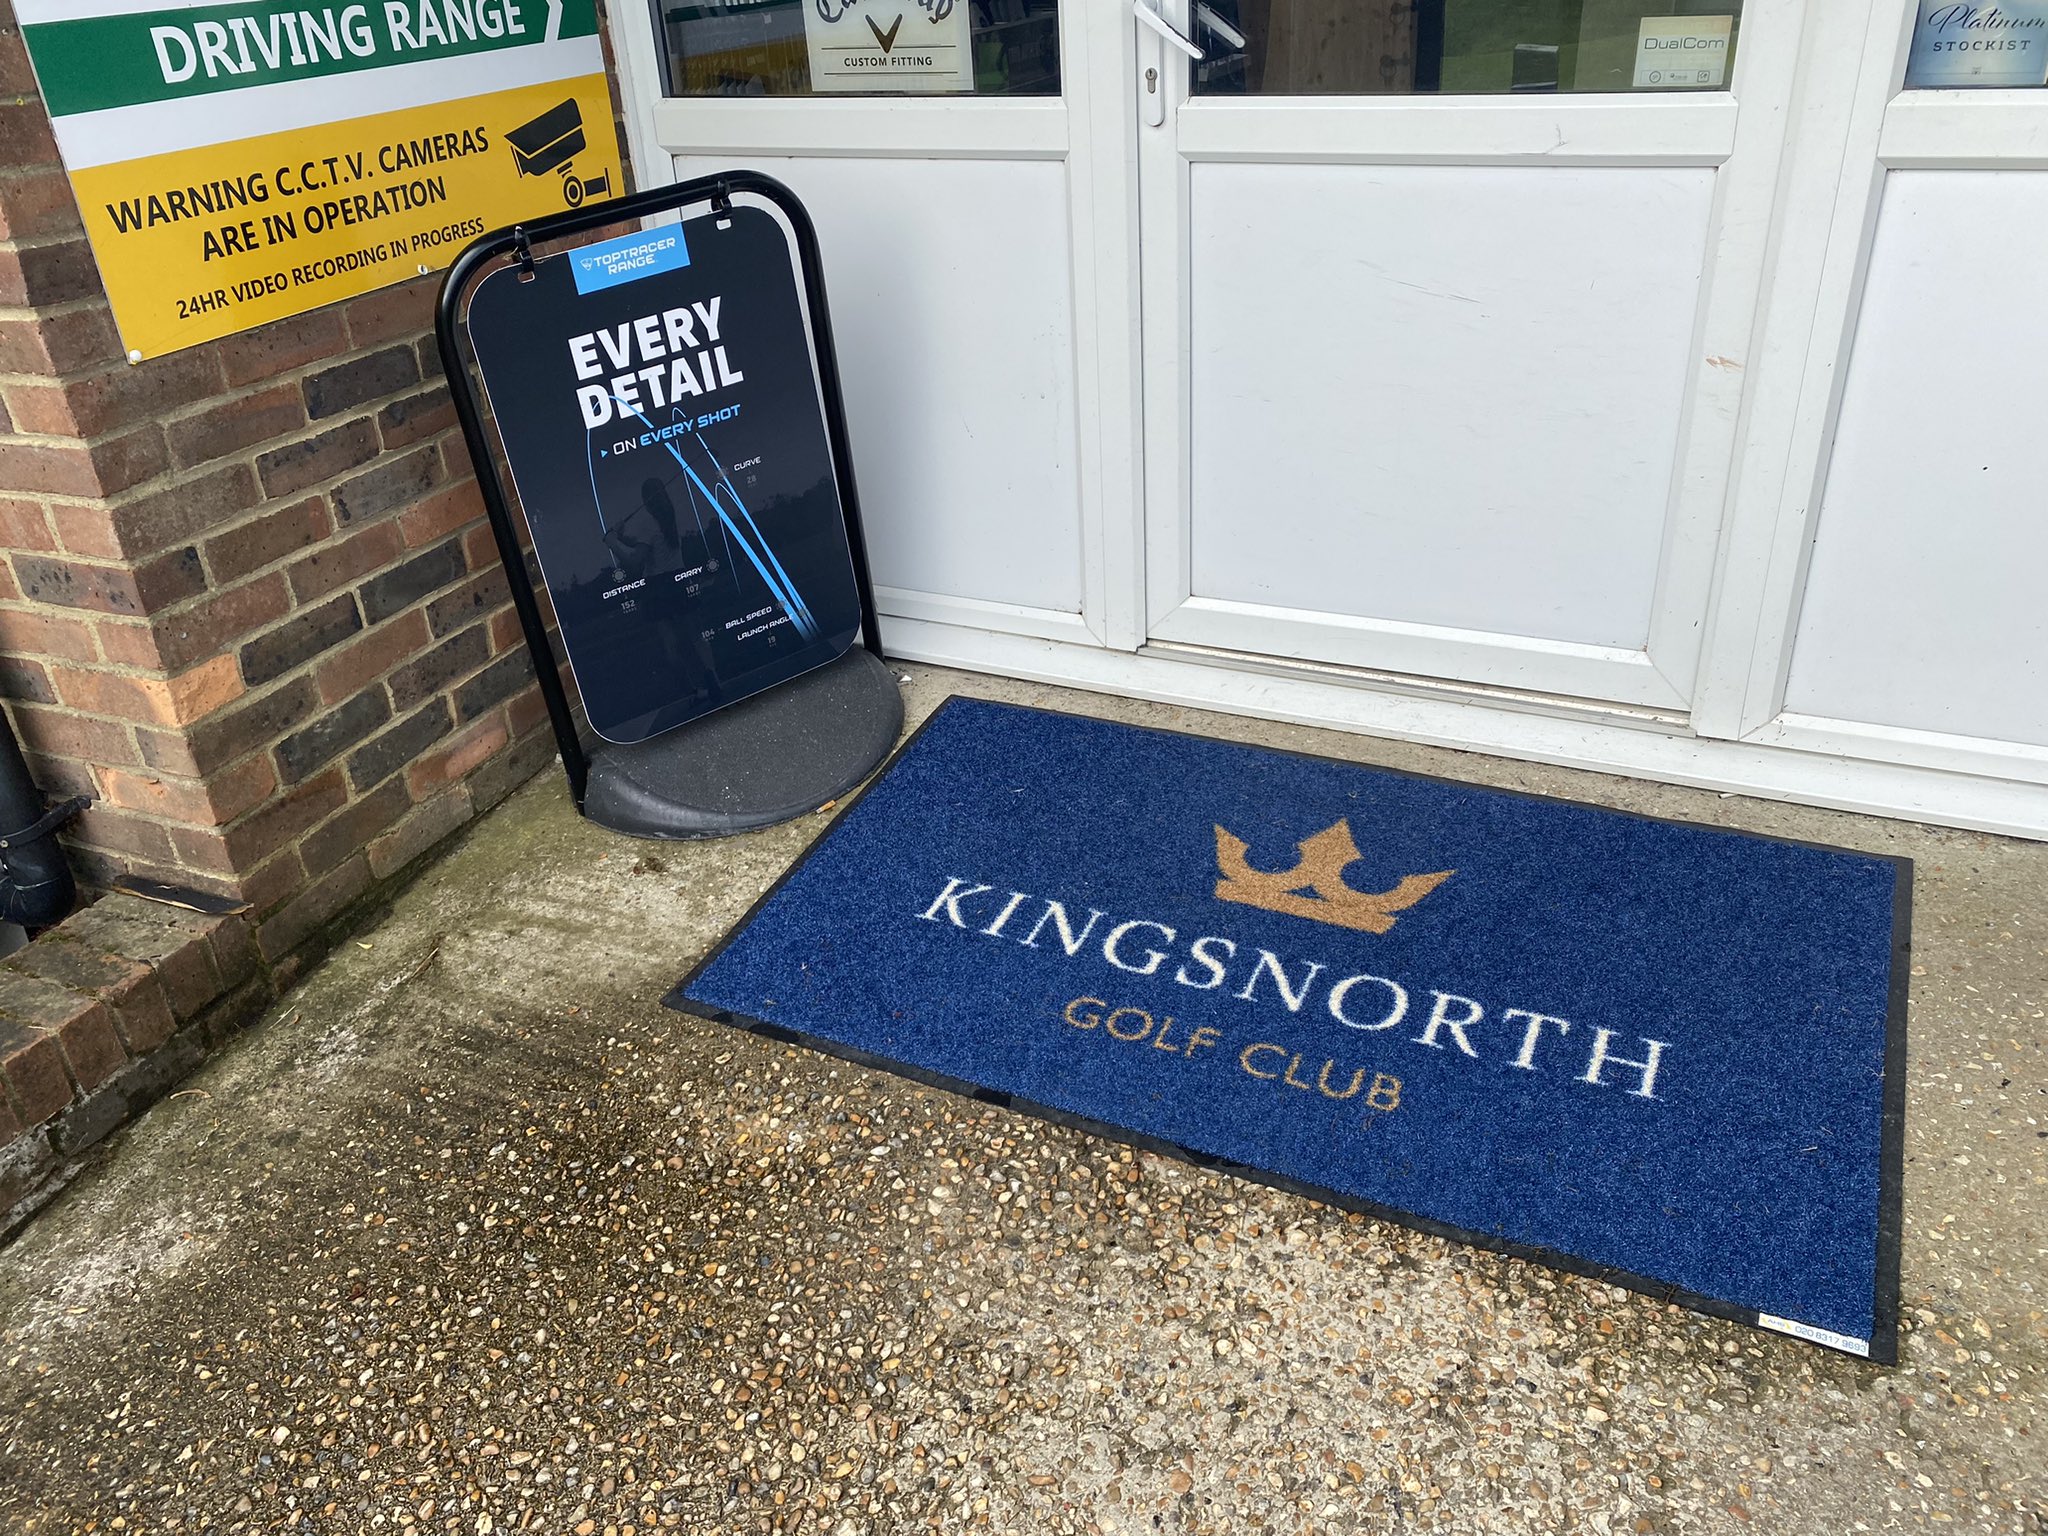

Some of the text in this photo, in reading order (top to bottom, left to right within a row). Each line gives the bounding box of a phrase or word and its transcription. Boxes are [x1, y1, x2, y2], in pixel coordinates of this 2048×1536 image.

[1928, 3, 2046, 33] Platinum
[150, 0, 527, 84] DRIVING RANGE
[1644, 37, 1725, 50] DualCom
[1932, 40, 2031, 52] STOCKIST
[844, 56, 933, 67] CUSTOM FITTING
[106, 126, 490, 235] WARNING C.C.T.V. CAMERAS
[202, 175, 447, 262] ARE IN OPERATION
[594, 236, 677, 267] TOPTRACER
[608, 253, 656, 275] RANGE
[176, 216, 486, 320] 24HR VIDEO RECORDING IN PROGRESS
[568, 296, 722, 381] EVERY
[575, 345, 745, 430] DETAIL
[612, 403, 742, 457] ON EVERY SHOT
[733, 456, 762, 472] CURVE
[674, 566, 704, 582] CARRY
[602, 579, 647, 600] DISTANCE
[685, 583, 700, 594] 107
[620, 599, 636, 610] 152
[725, 605, 773, 630] BALL SPEED
[737, 613, 794, 641] LAUNCH ANGLE
[914, 876, 1674, 1102] KINGSNORTH
[1063, 995, 1404, 1112] GOLF CLUB
[1794, 1325, 1815, 1338] 020
[1815, 1331, 1840, 1345] 8317
